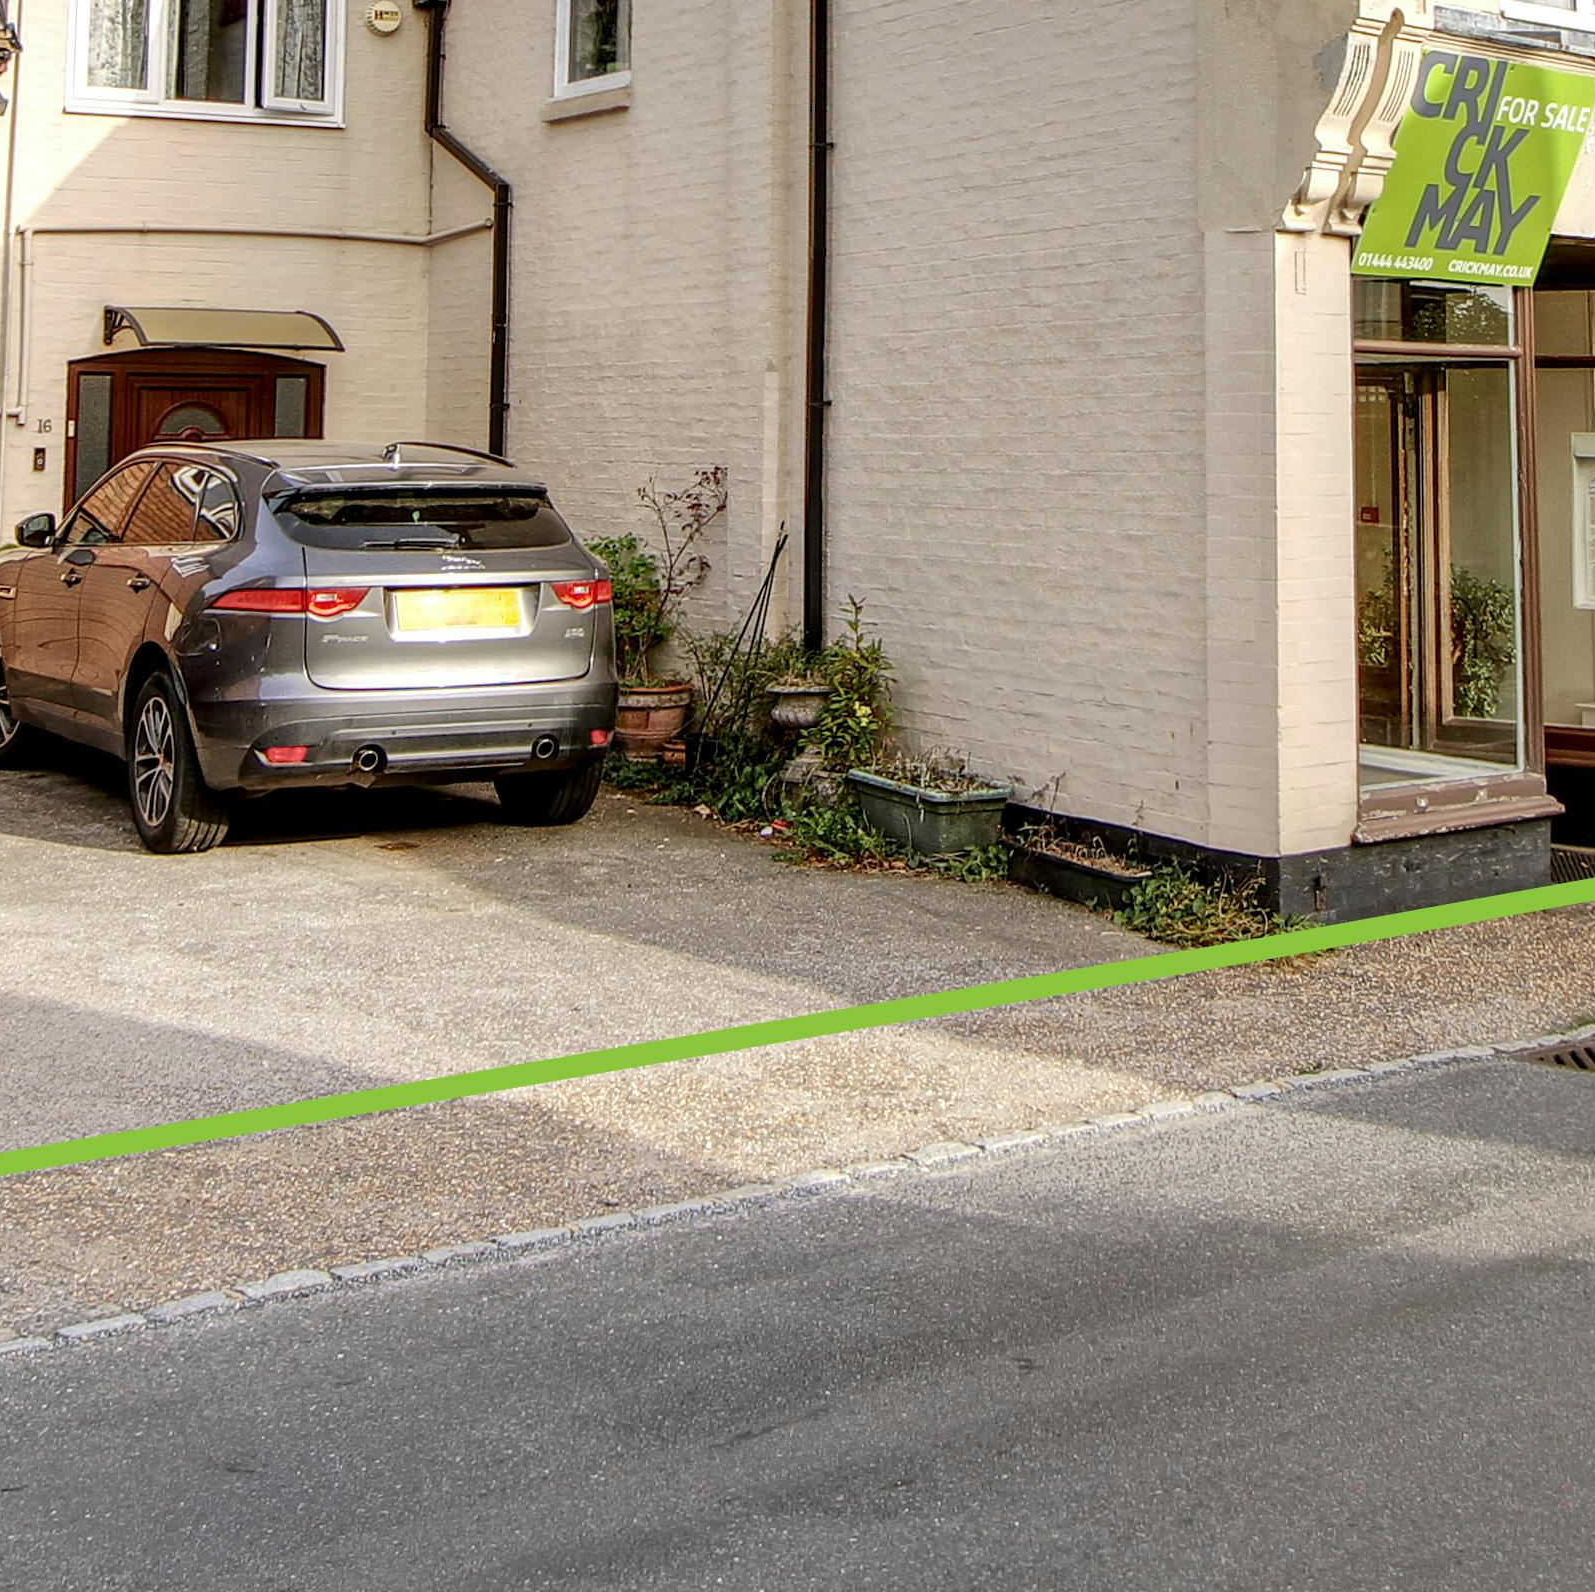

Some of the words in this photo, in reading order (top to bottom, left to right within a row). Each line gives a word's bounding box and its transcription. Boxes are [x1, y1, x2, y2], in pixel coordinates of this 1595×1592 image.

[1497, 96, 1538, 126] FOR
[1541, 103, 1591, 133] SALE
[1358, 252, 1392, 269] 01444
[1394, 256, 1433, 271] 443400
[1448, 259, 1534, 279] CRICKMAY.CO.UK
[37, 419, 52, 434] 16
